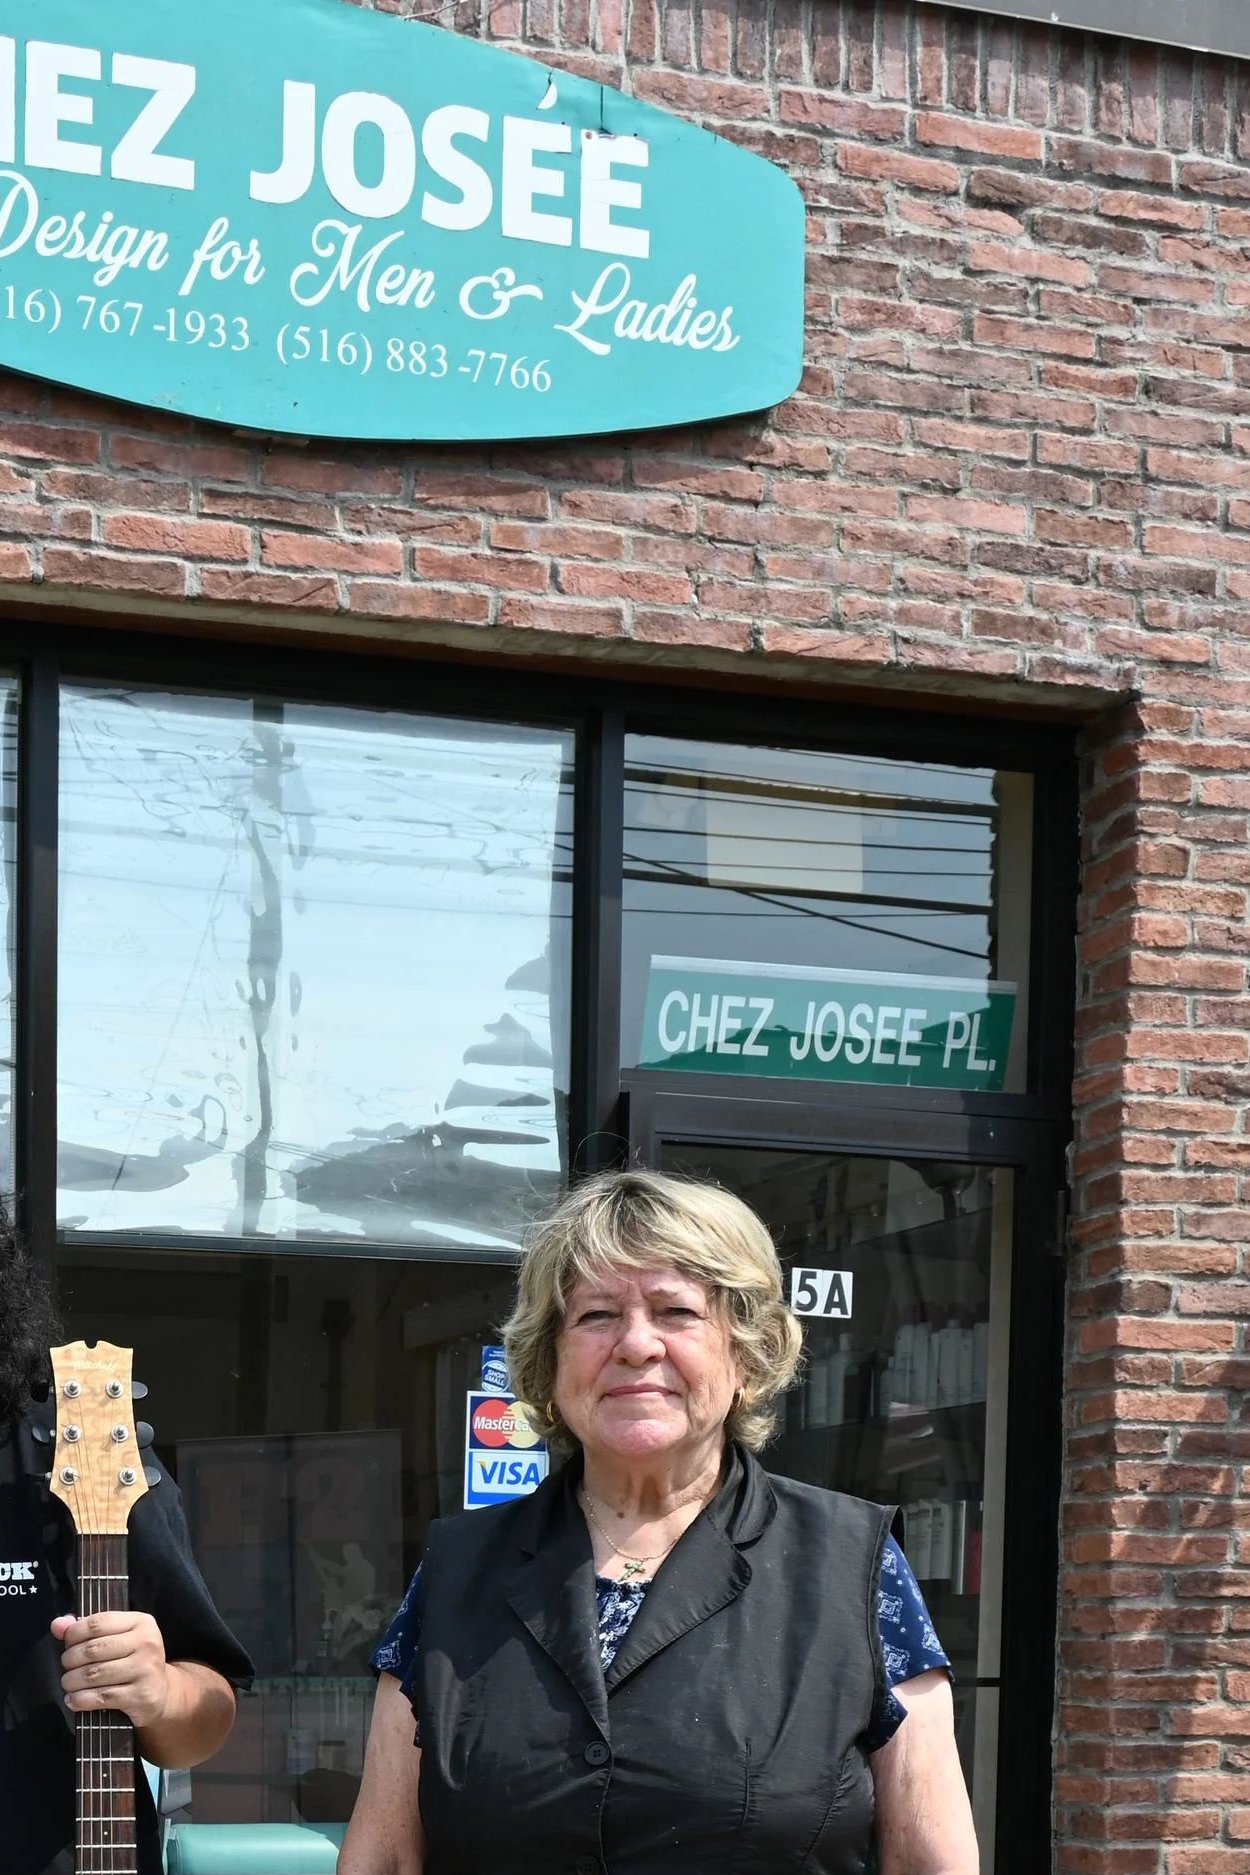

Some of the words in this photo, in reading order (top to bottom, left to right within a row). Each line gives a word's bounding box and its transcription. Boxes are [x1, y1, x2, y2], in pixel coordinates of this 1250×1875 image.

[249, 79, 651, 259] JOSÉE
[178, 216, 266, 296] for
[290, 219, 436, 312] Men
[458, 267, 544, 320] &
[553, 262, 741, 355] Ladies
[275, 322, 373, 375] (516)
[658, 990, 775, 1057] CHEZ
[790, 1001, 927, 1066] JOSEE
[942, 1011, 996, 1072] PL.
[795, 1270, 850, 1316] 5A
[71, 1359, 118, 1373] Mitchell
[484, 1375, 505, 1386] SMALL
[488, 1369, 506, 1379] SHOP
[473, 1416, 533, 1432] MasterCa
[477, 1458, 541, 1486] VISA
